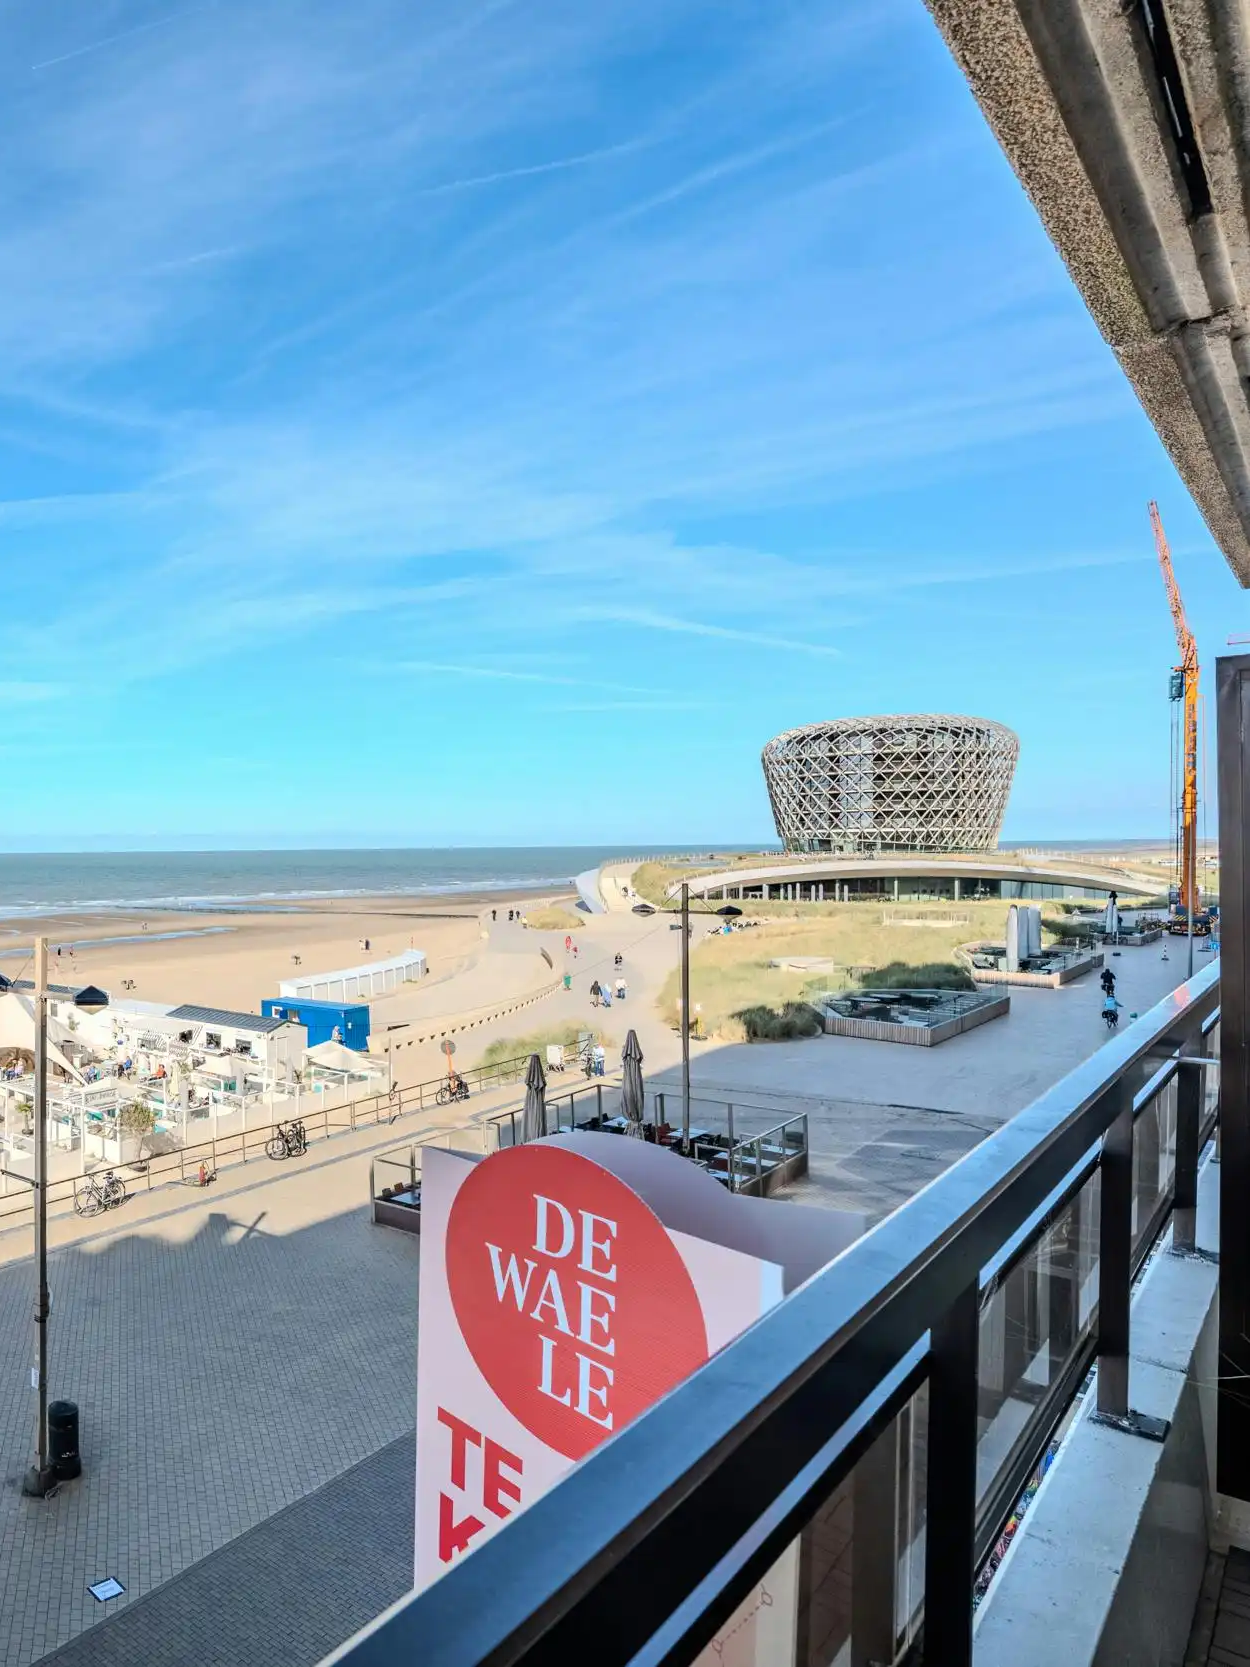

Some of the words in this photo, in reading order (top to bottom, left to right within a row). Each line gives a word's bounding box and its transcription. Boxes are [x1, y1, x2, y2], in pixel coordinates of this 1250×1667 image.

[532, 1193, 617, 1282] DE
[485, 1241, 615, 1357] WAE
[537, 1334, 614, 1431] LE
[437, 1406, 523, 1519] TE
